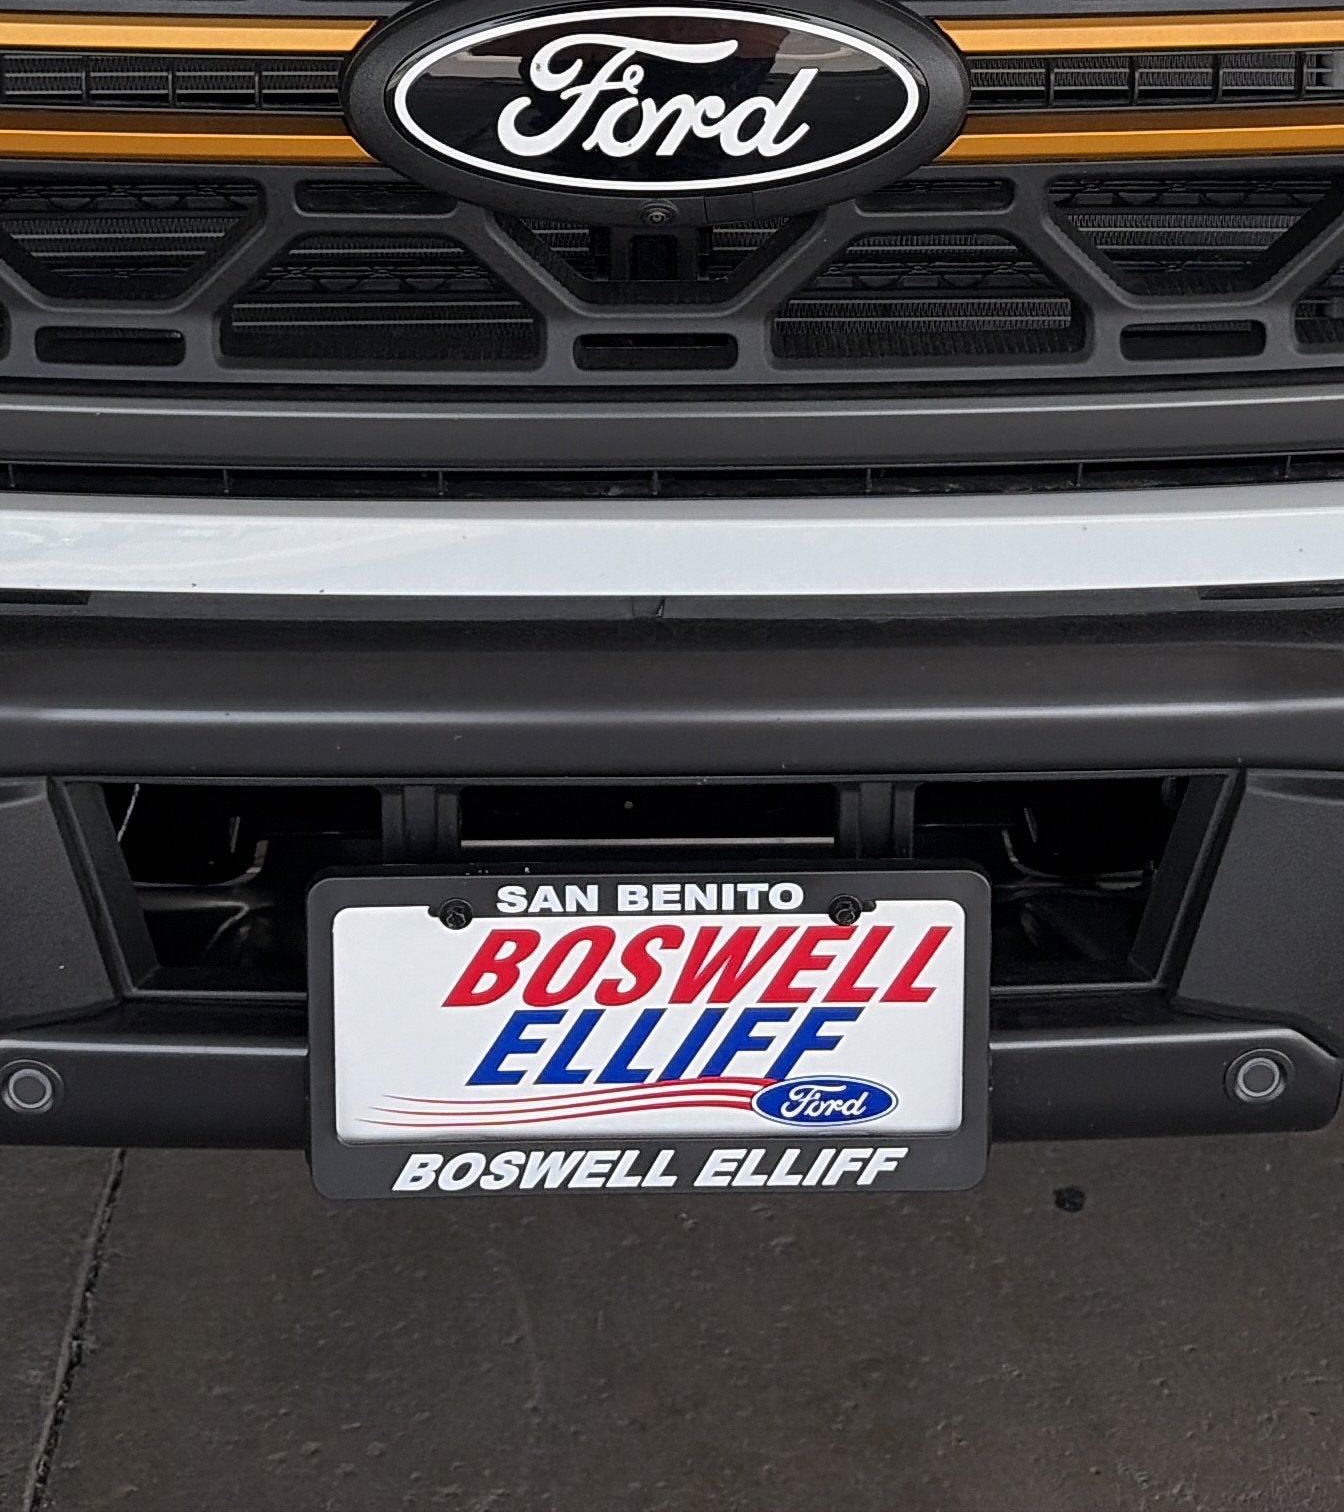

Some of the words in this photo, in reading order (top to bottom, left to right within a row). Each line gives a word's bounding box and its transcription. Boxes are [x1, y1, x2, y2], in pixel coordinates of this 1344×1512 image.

[498, 33, 818, 157] Ford
[497, 884, 607, 914] SAN
[617, 882, 803, 912] BENITO
[441, 924, 953, 1008] BOSWELL
[465, 1006, 866, 1087] ELLIFF
[780, 1085, 869, 1119] Ford
[392, 1149, 677, 1191] BOSWELL
[693, 1147, 908, 1186] ELLIFF
